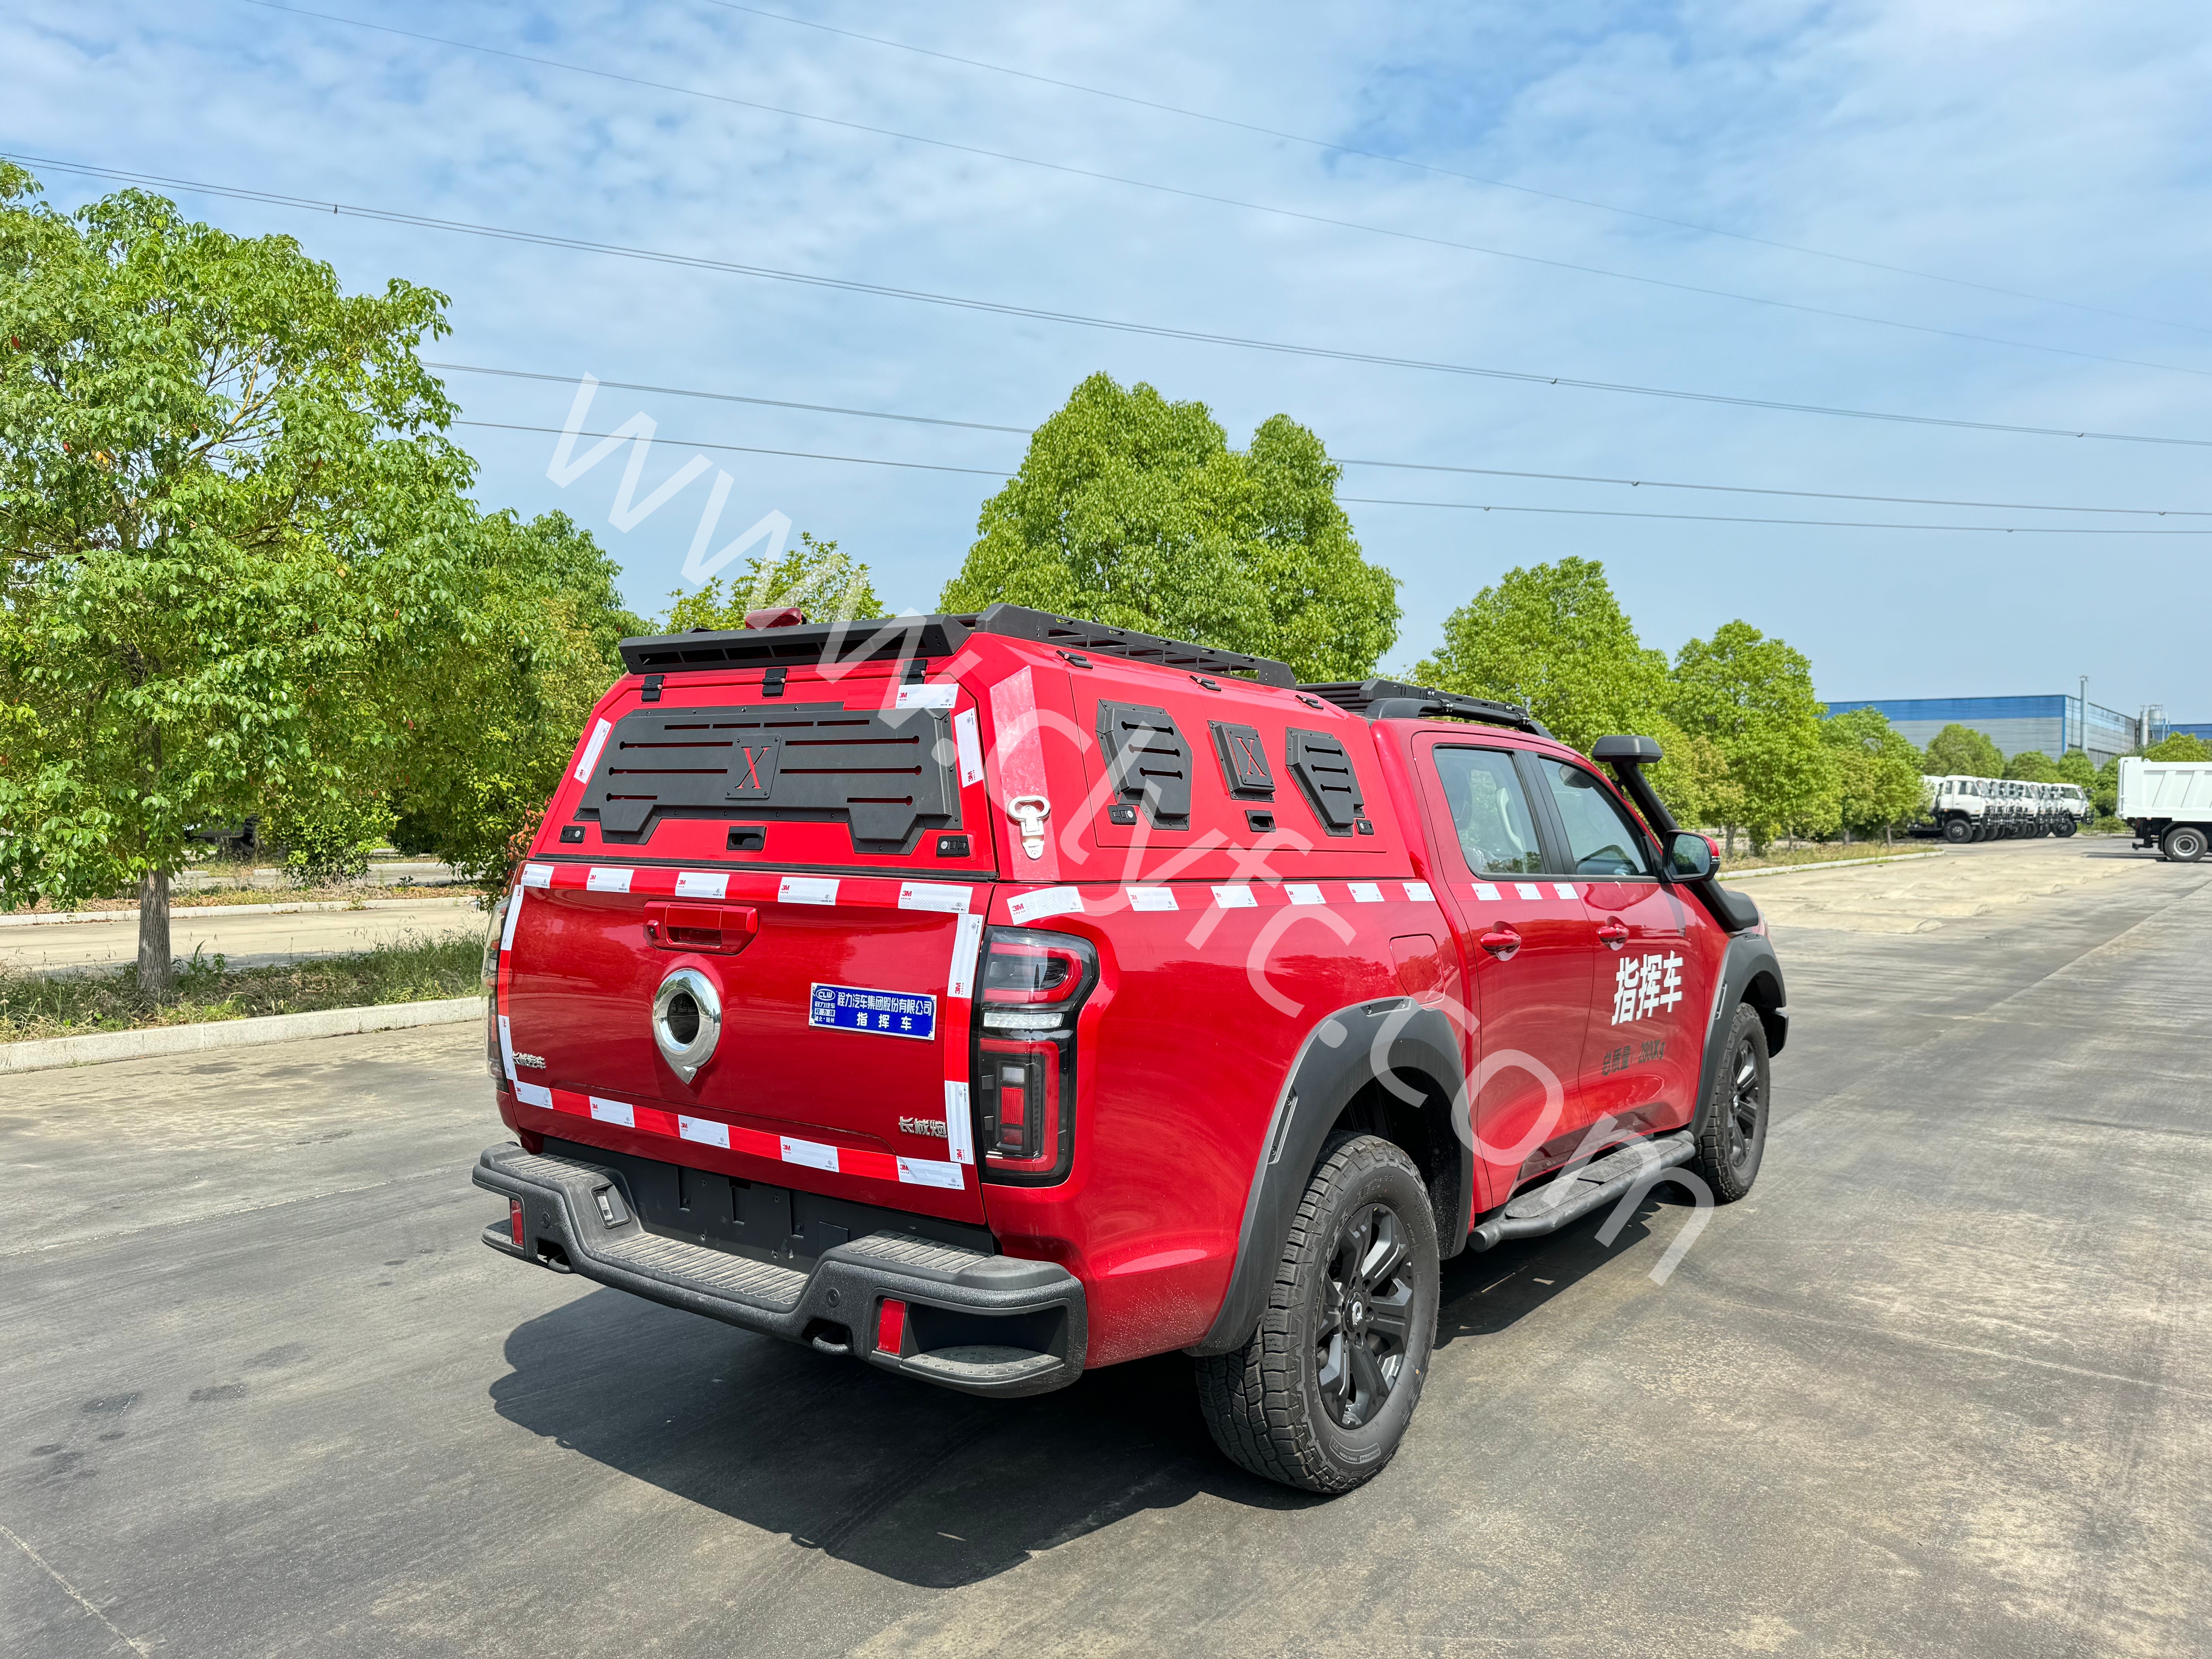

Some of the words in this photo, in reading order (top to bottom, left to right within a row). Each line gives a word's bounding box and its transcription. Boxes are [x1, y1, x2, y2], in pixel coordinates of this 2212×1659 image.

[1235, 736, 1267, 776] X
[735, 746, 771, 789] X
[968, 771, 973, 782] 3M
[1013, 903, 1024, 912] 3M
[955, 982, 961, 994] 3M
[1611, 950, 1683, 1025] 指挥车
[837, 992, 932, 1016] 程力汽车集团股份有限公司
[857, 1012, 912, 1031] 指挥车
[898, 1116, 947, 1138] 长城炮
[957, 1149, 962, 1159] 3M
